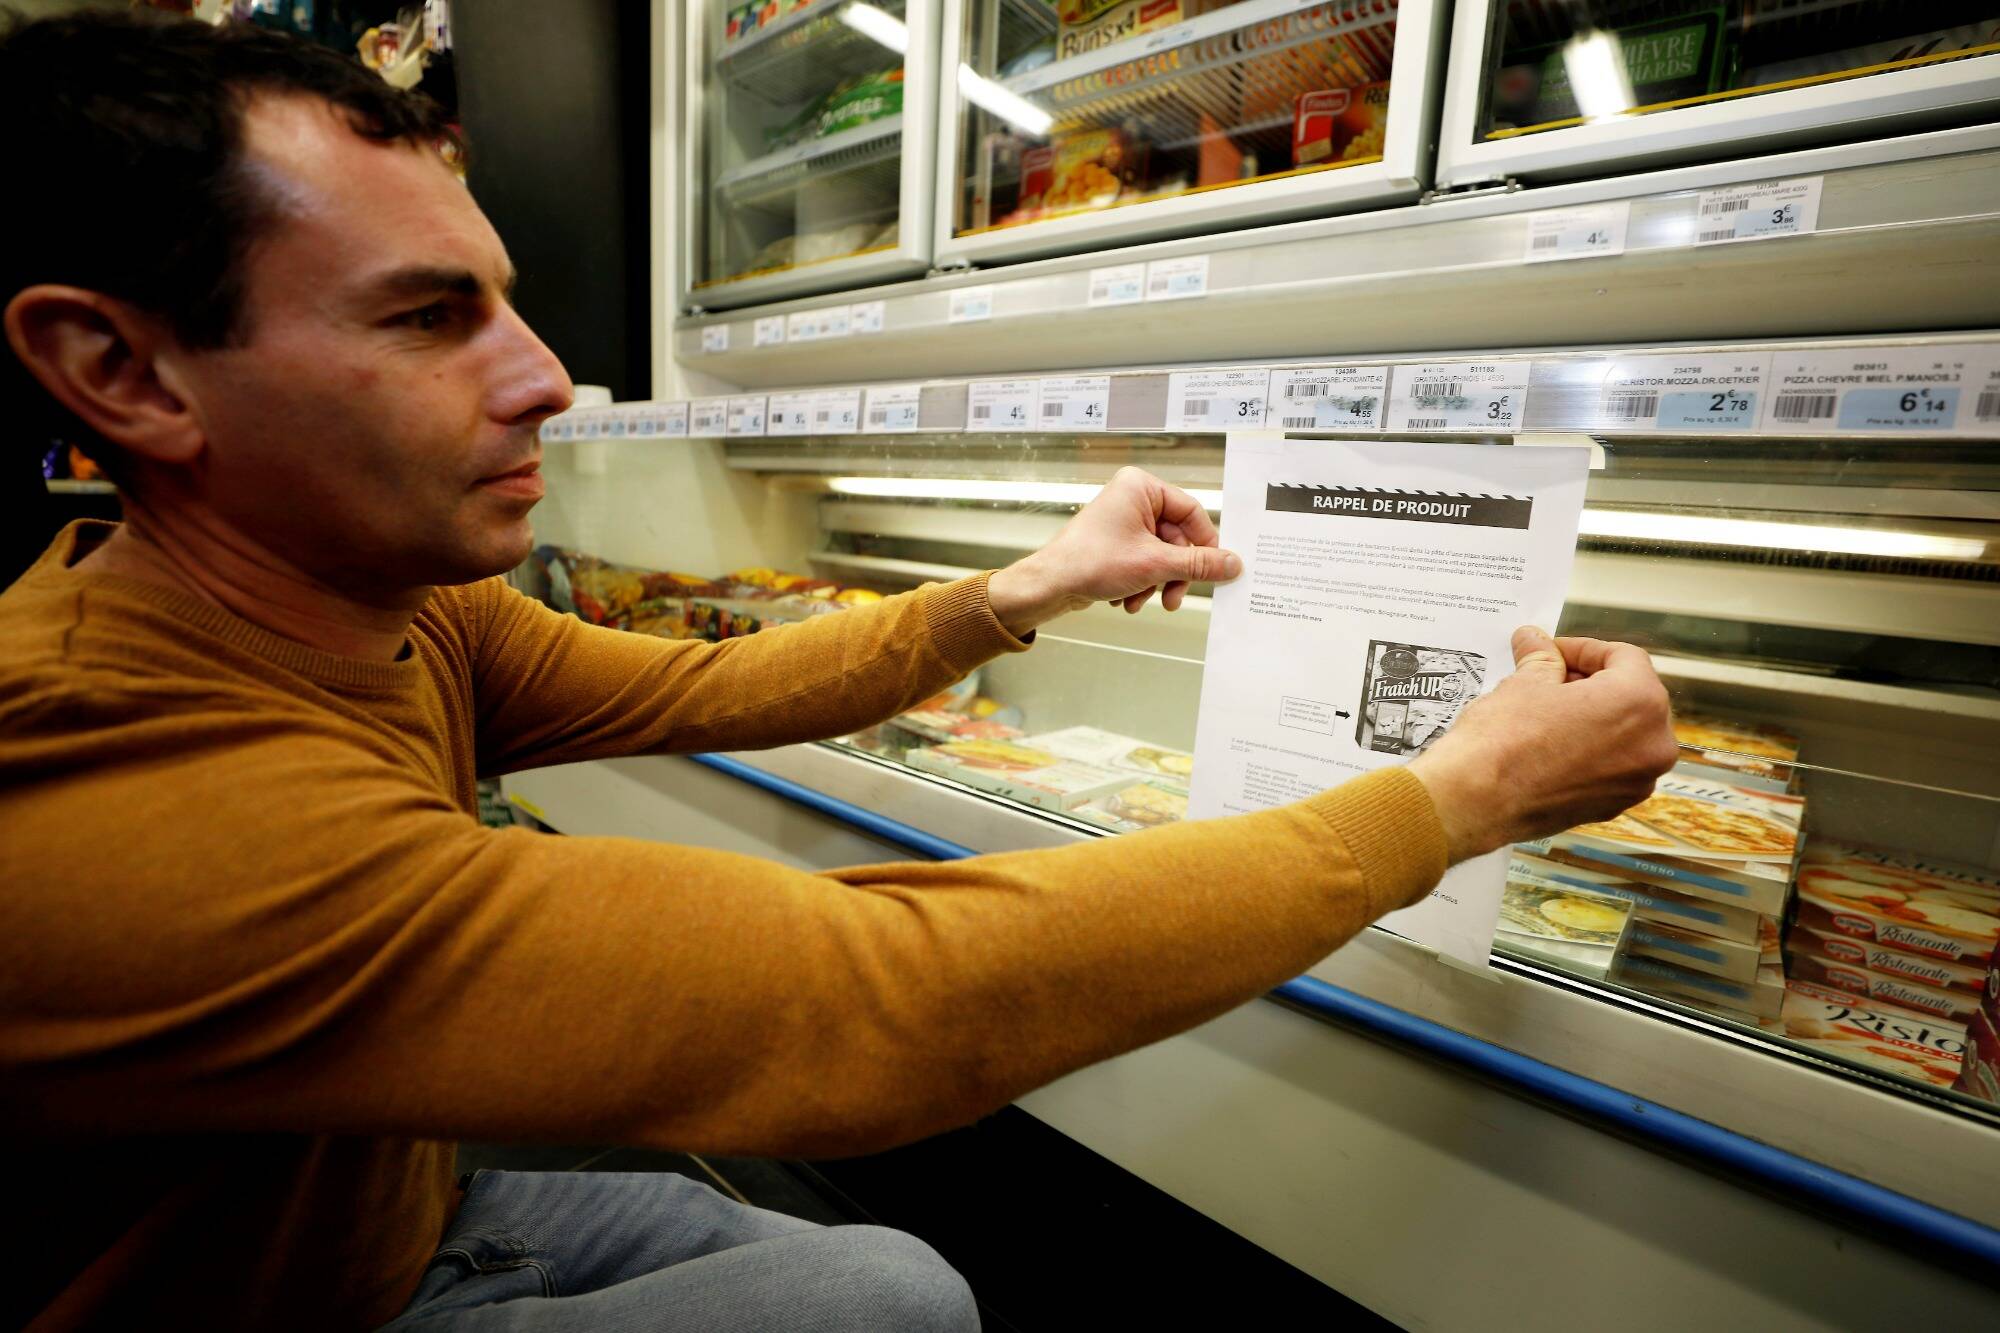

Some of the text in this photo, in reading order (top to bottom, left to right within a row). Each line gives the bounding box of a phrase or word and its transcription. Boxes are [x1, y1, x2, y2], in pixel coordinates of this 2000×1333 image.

[1622, 32, 1696, 65] HÈVRE
[1784, 375, 1814, 383] PIZZA
[1817, 374, 1862, 383] CHEVRE
[1866, 374, 1892, 382] MIEL
[1313, 495, 1472, 519] RAPPEL DE PRODUIT
[1415, 564, 1436, 572] rappel
[1510, 573, 1523, 581] des
[1634, 861, 1675, 878] TONNO
[1879, 925, 1962, 955] Ristorante
[1870, 951, 1950, 980] Ristorante
[1873, 980, 1953, 1010] Ristorante
[1825, 1004, 1964, 1054] Risto
